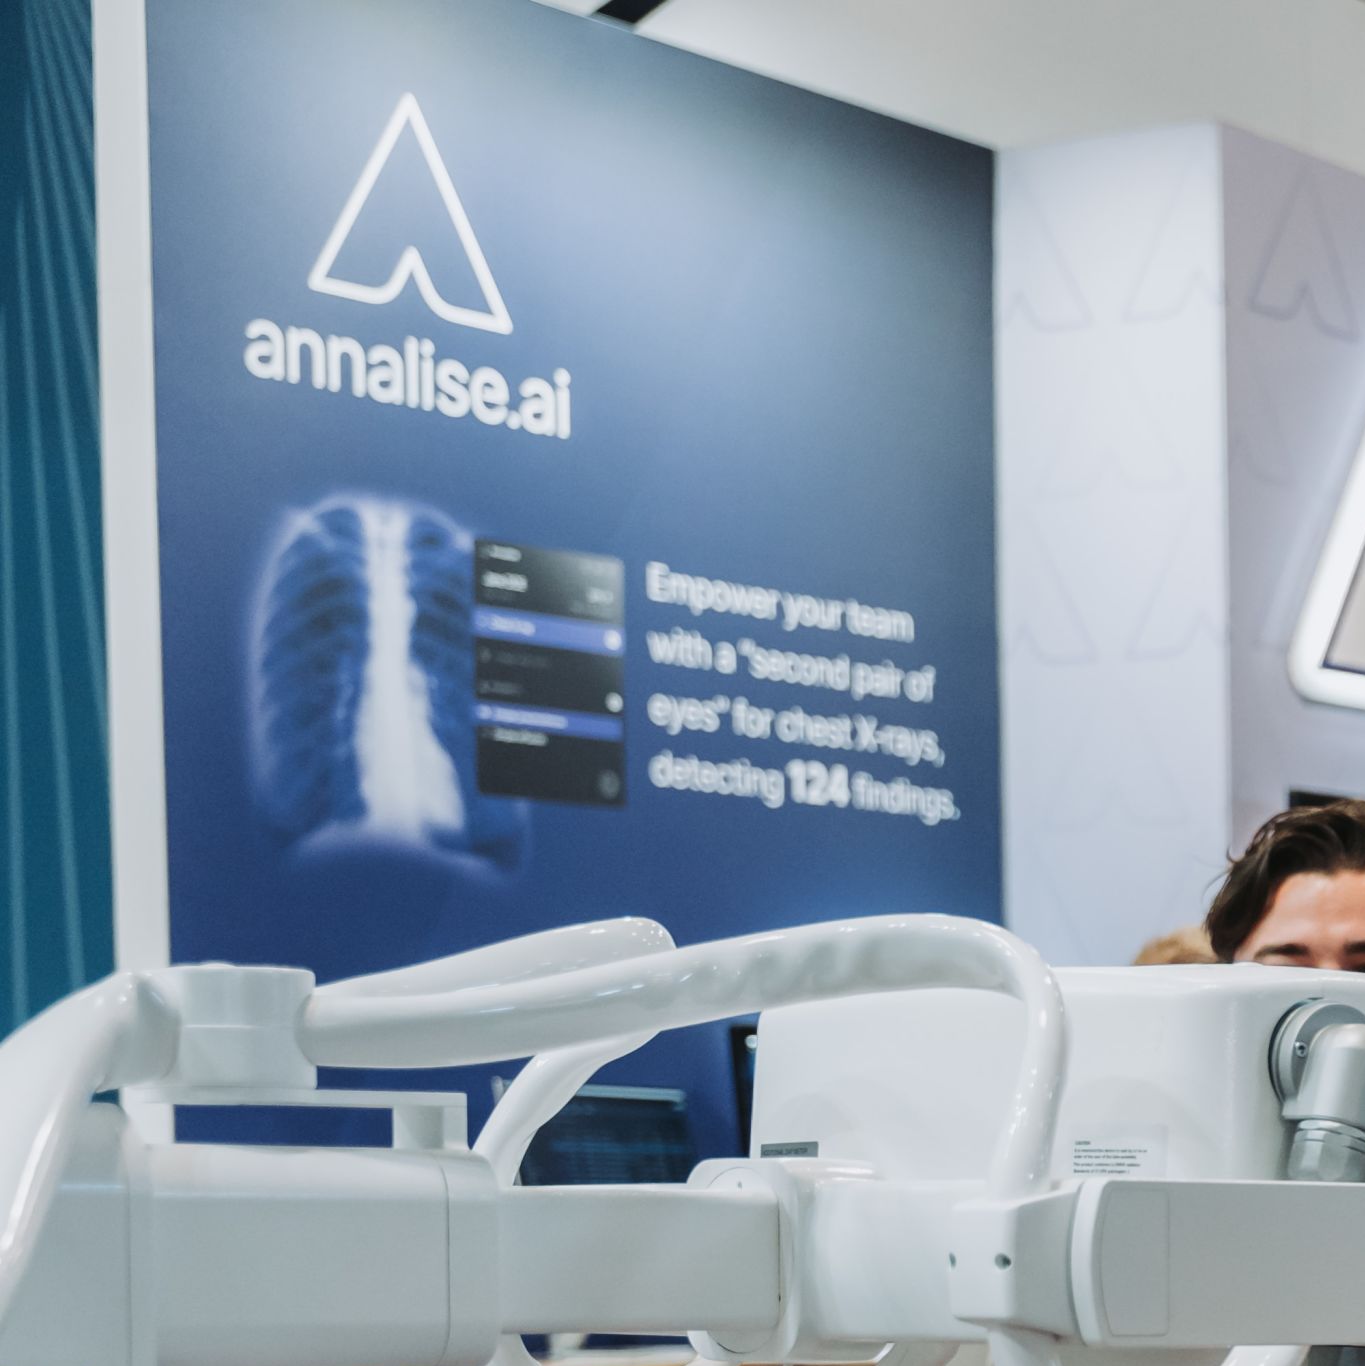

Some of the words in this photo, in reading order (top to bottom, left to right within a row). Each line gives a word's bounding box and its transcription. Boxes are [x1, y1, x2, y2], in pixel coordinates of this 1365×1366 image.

[242, 317, 572, 440] annalise.ai
[646, 561, 780, 619] Empower
[780, 591, 845, 631] your
[845, 598, 914, 643] team
[646, 626, 713, 670] with
[713, 640, 737, 675] a
[850, 659, 902, 701] pair
[903, 665, 936, 702] of
[731, 696, 775, 739] for
[775, 706, 852, 750] chest
[648, 749, 785, 809] detecting
[785, 758, 850, 808] 124
[850, 771, 961, 826] findings.
